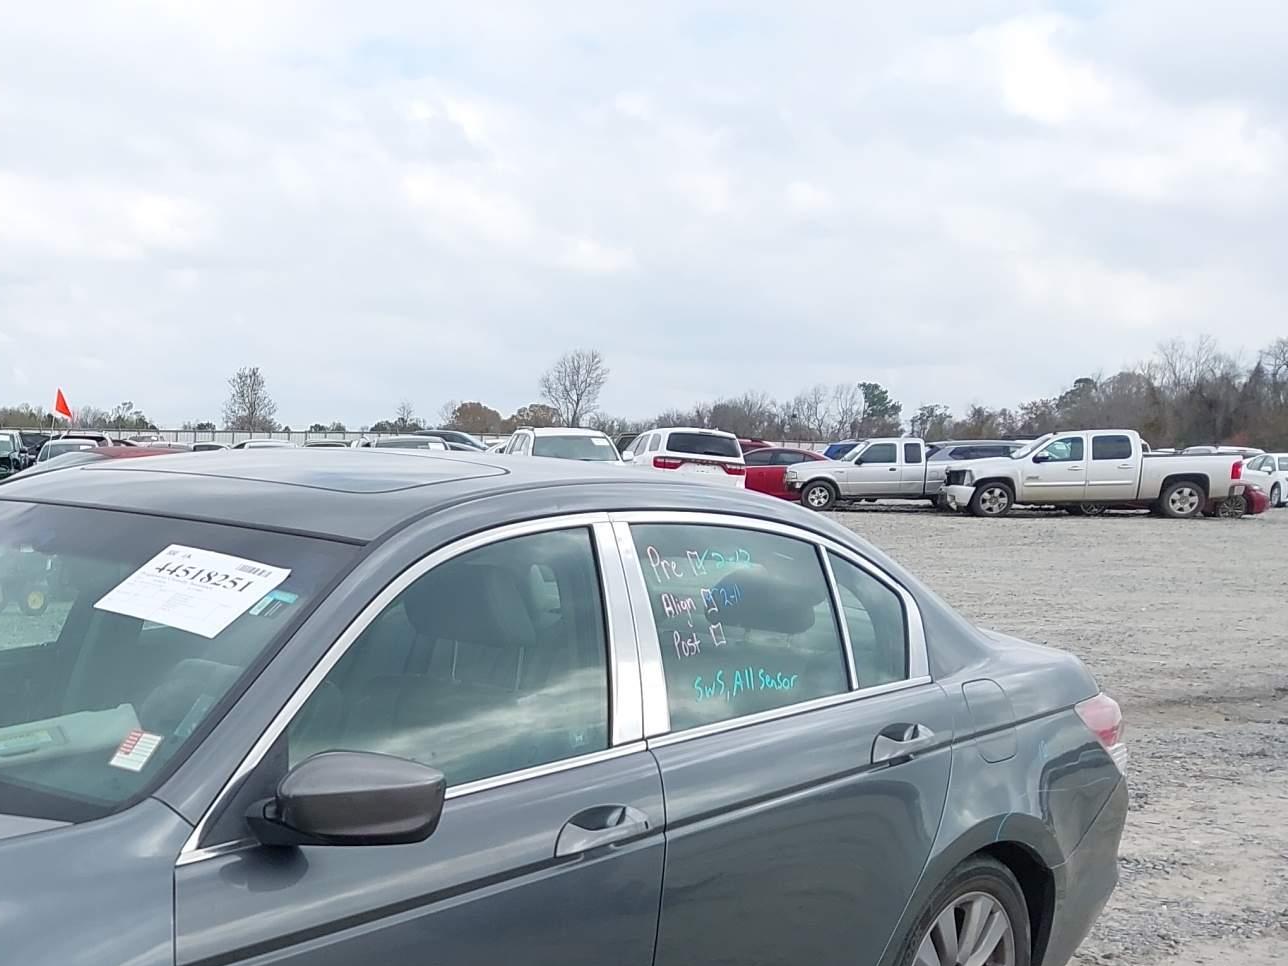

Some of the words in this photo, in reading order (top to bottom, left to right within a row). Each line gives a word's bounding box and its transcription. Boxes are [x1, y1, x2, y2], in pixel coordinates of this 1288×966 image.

[155, 561, 254, 592] 44518251
[646, 545, 684, 583] Pre
[661, 592, 696, 627] Align
[672, 630, 701, 661] Post
[732, 666, 755, 697] All
